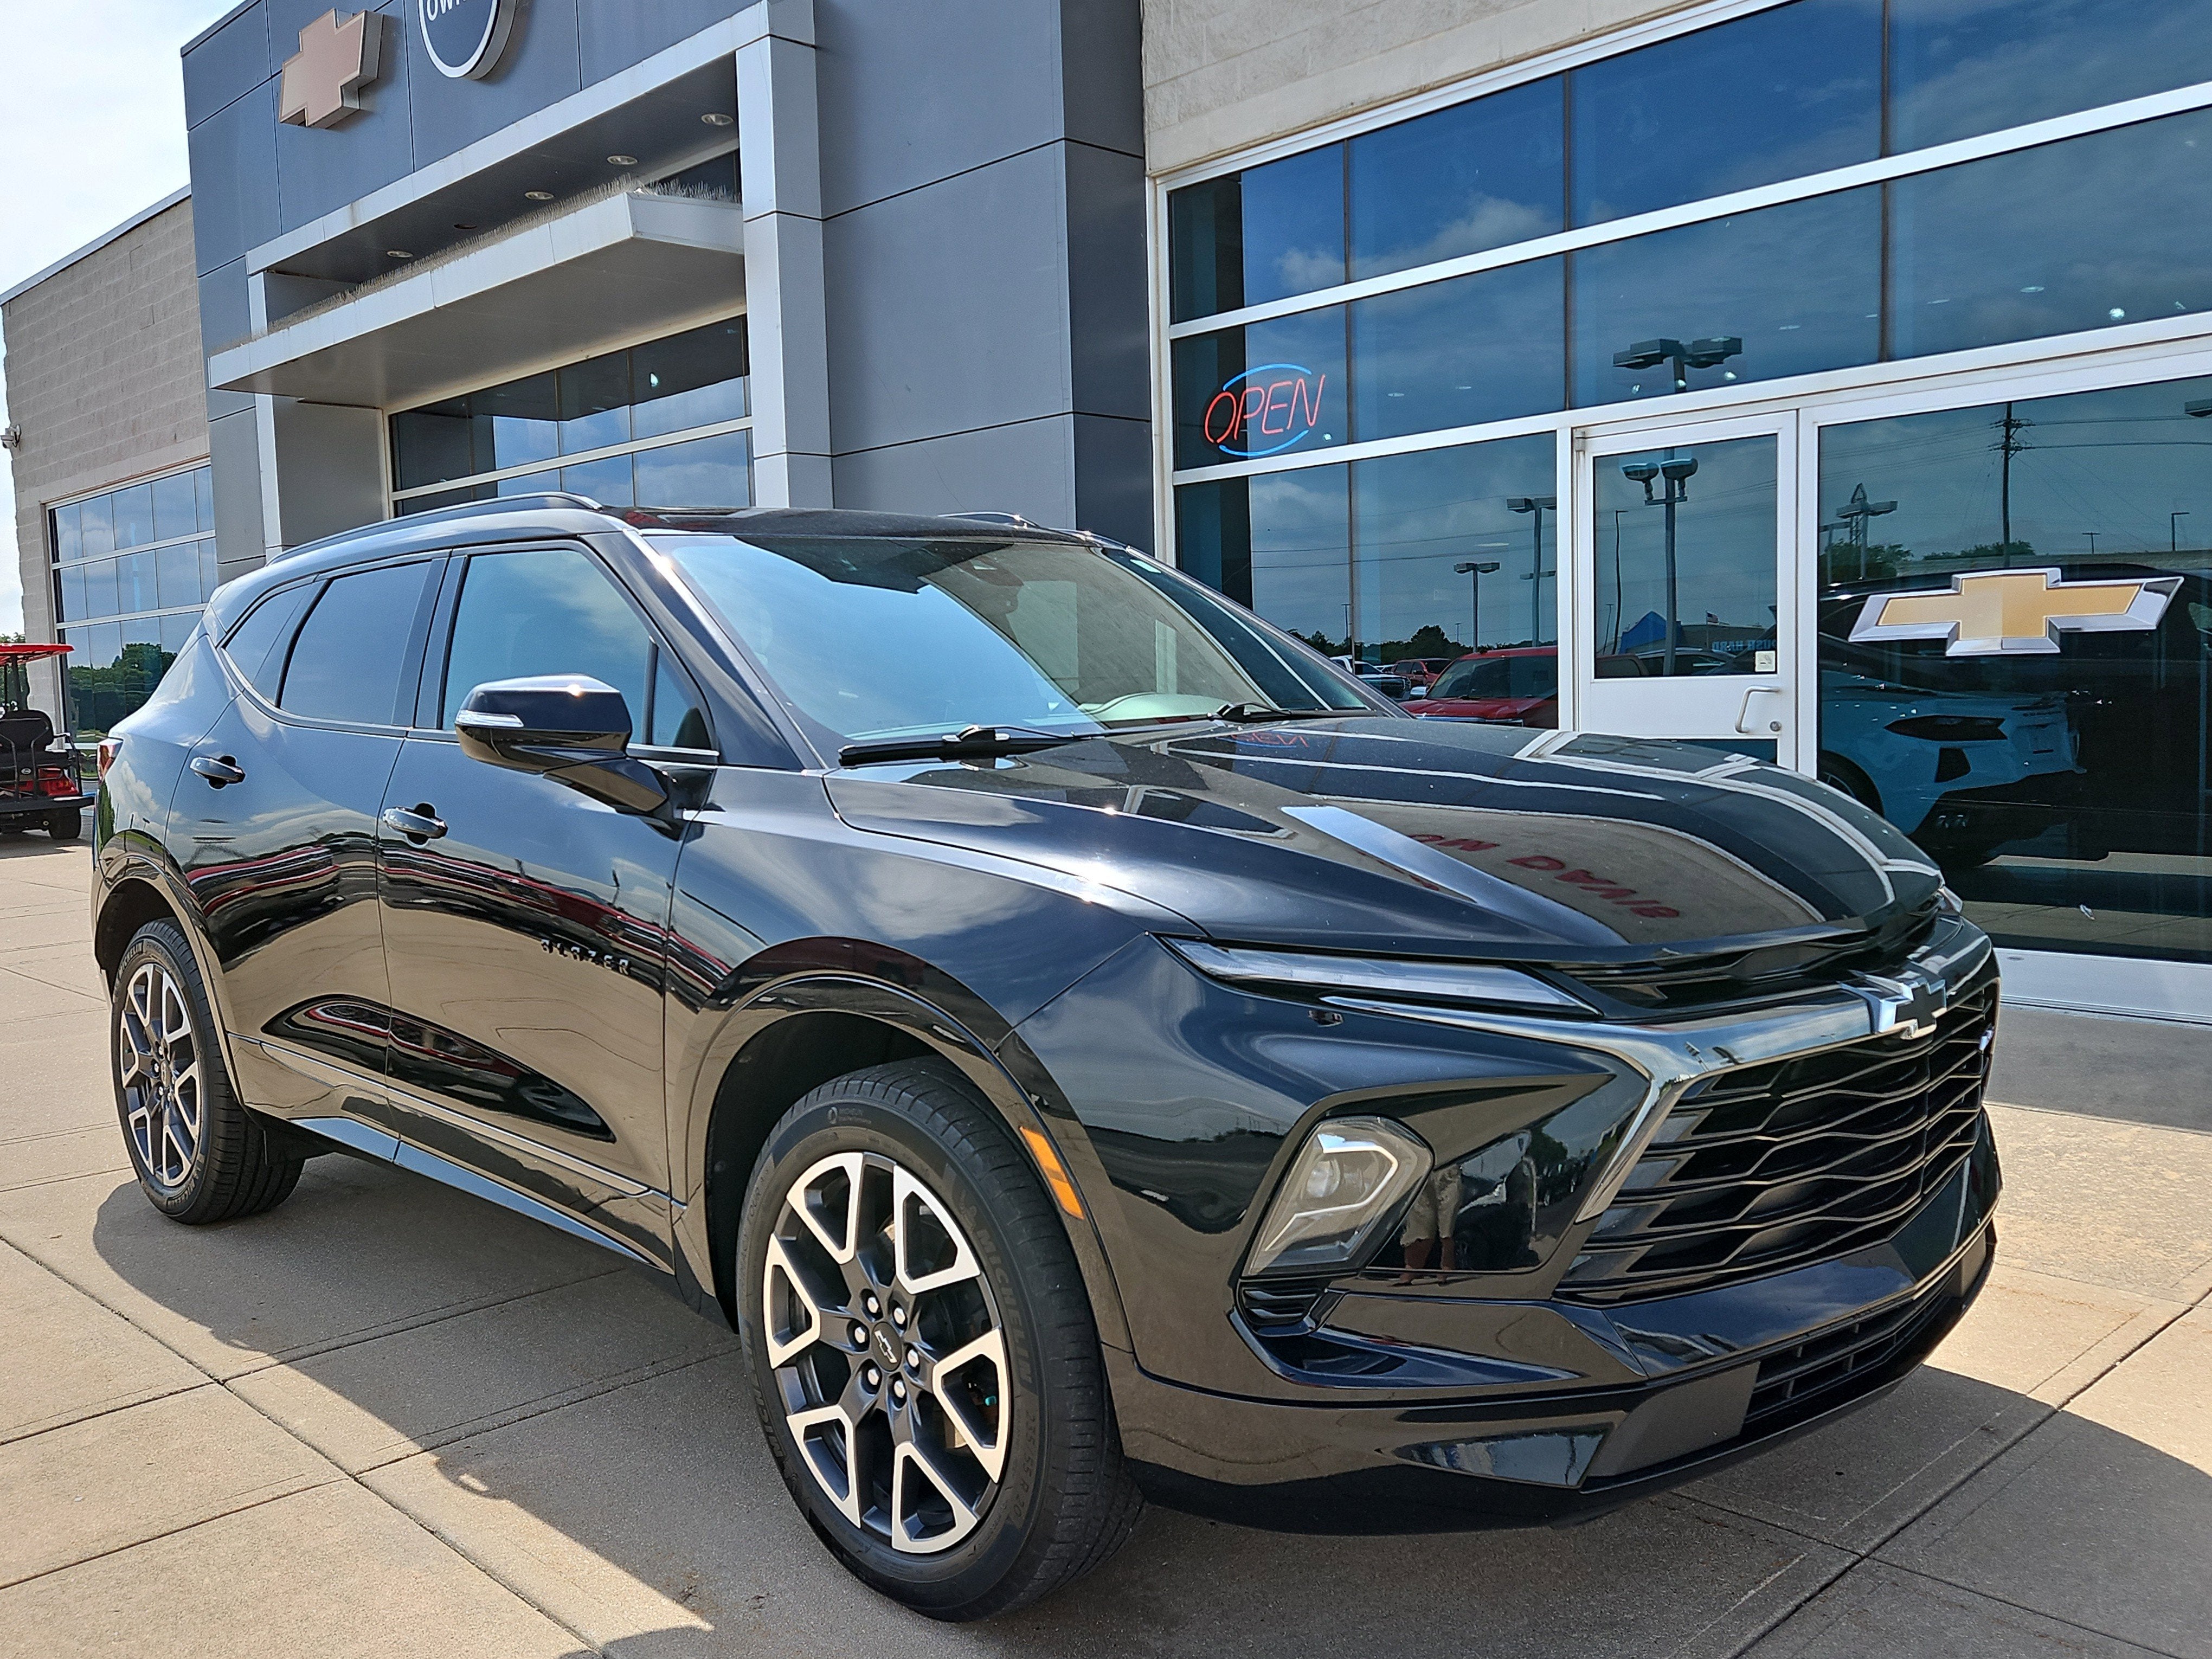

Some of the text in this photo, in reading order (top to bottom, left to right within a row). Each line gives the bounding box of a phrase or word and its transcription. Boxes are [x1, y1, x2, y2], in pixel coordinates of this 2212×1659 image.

[1204, 374, 1326, 443] OPEN
[541, 938, 629, 976] BLAZER
[976, 1229, 1031, 1383] MICHELIN
